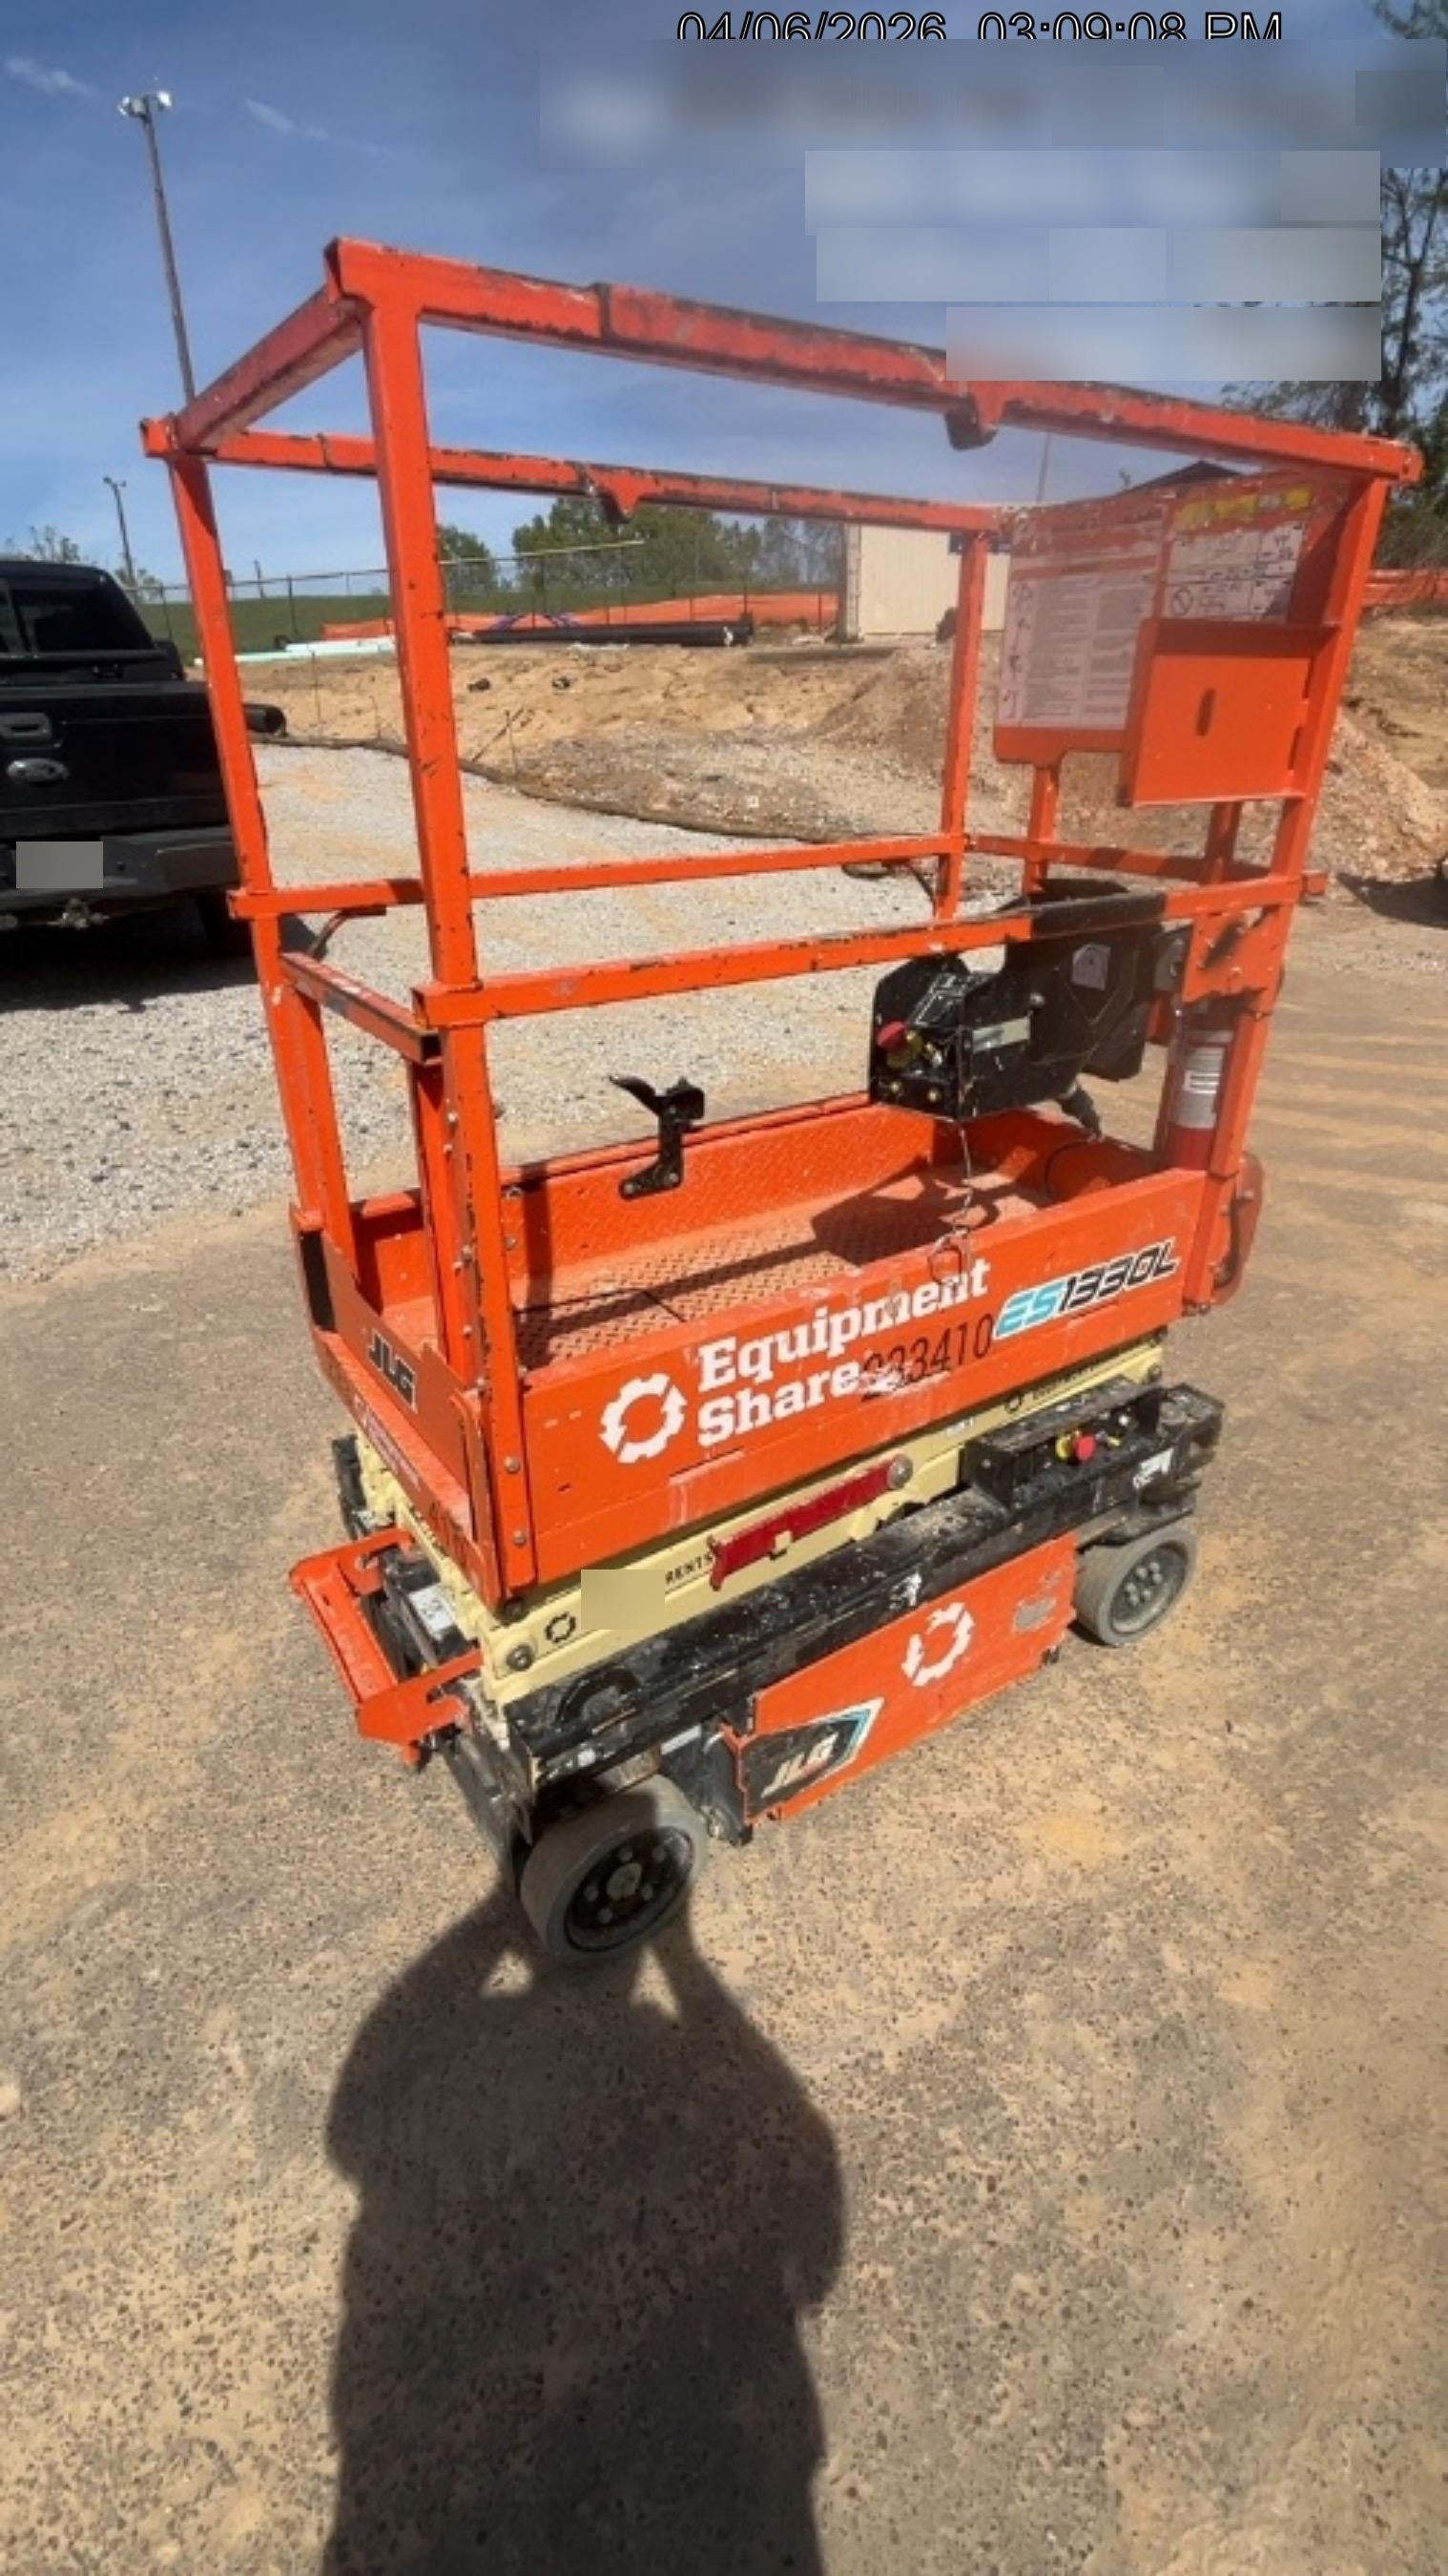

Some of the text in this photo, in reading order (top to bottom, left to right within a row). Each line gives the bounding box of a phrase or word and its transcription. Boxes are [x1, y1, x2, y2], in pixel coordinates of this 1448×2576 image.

[697, 1257, 990, 1393] Equipment
[995, 1239, 1179, 1339] ES1330L
[367, 1329, 418, 1413] JLG
[697, 1361, 860, 1447] Share
[761, 1732, 839, 1798] JLG
